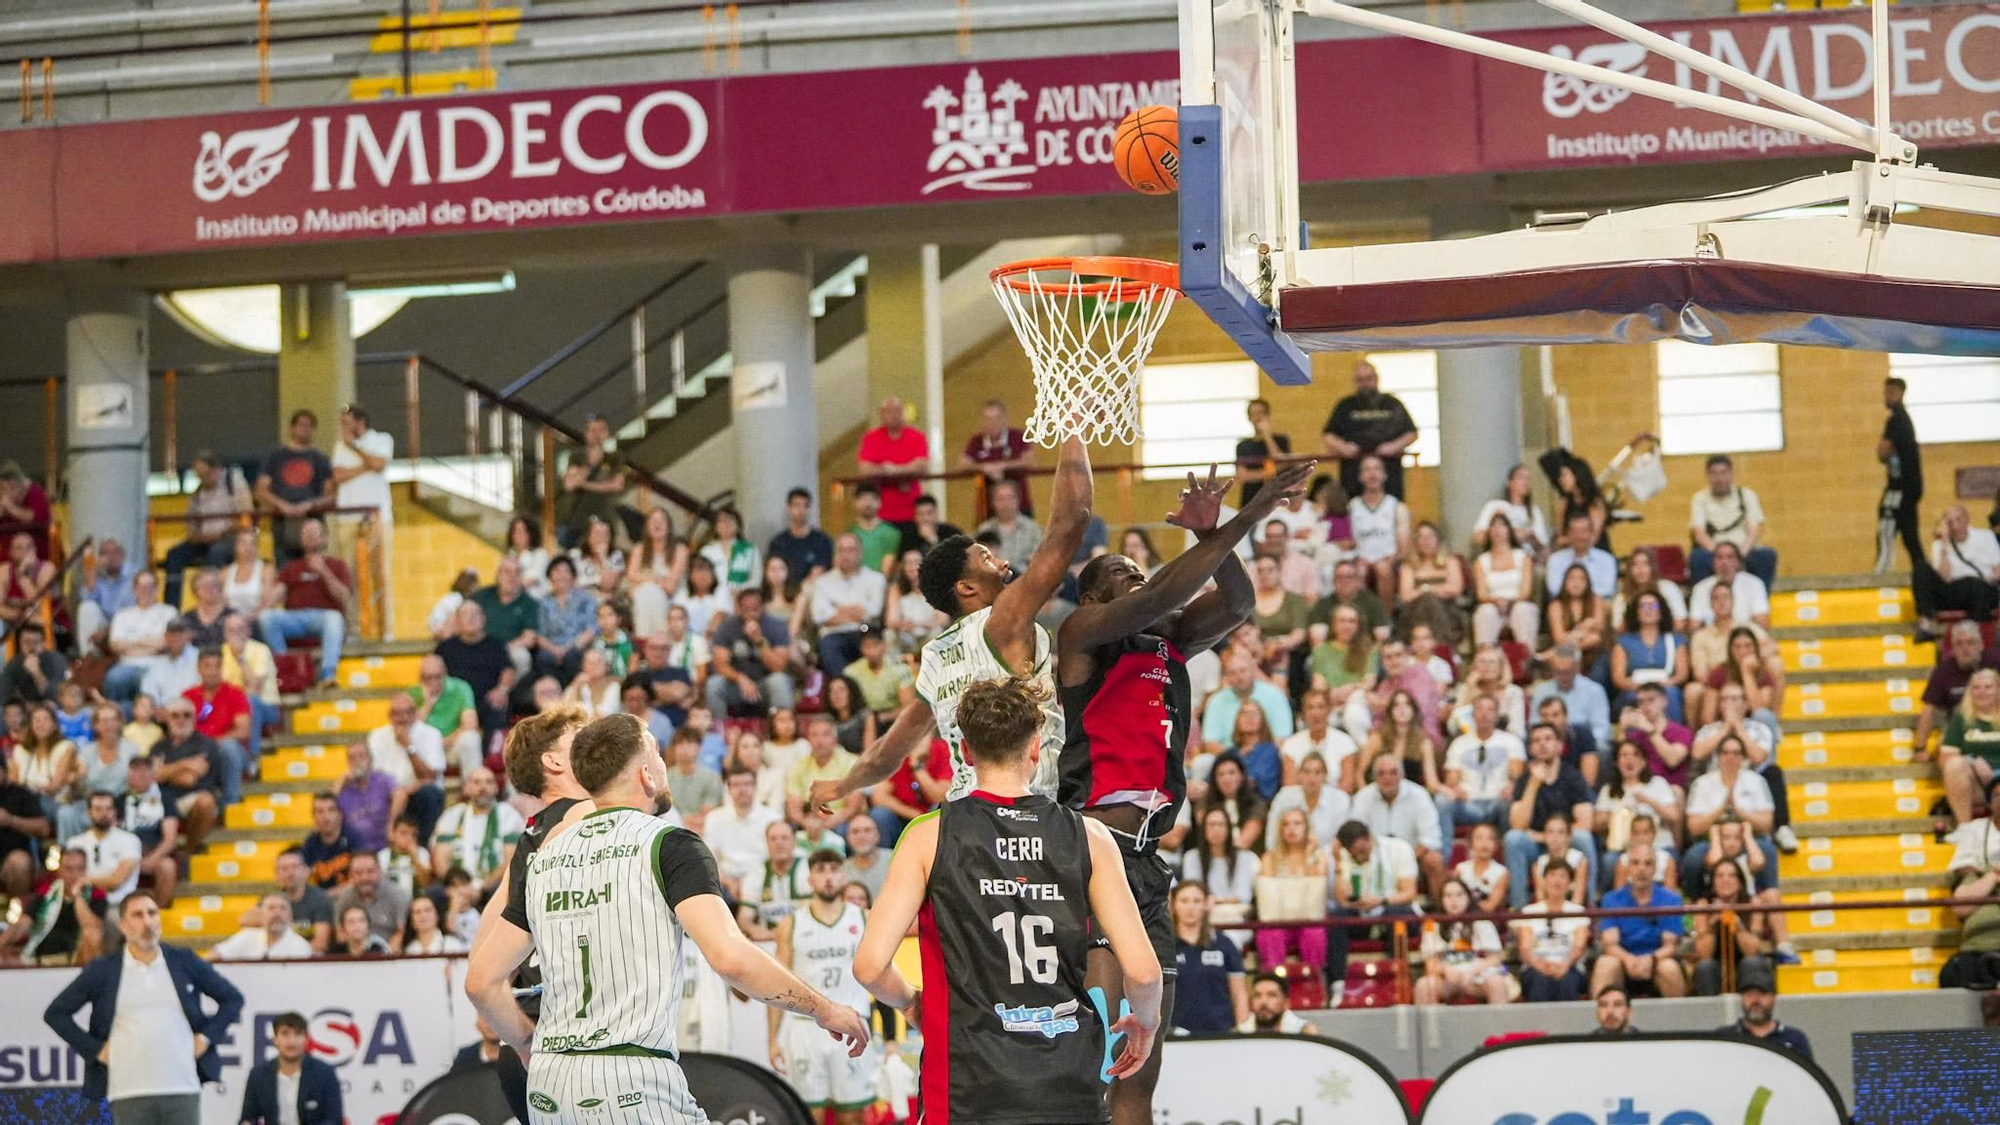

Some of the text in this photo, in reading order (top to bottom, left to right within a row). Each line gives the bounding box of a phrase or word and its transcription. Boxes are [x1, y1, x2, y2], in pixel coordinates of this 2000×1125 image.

[311, 90, 709, 192] IMDECO
[1036, 129, 1073, 166] DE
[1547, 132, 1660, 158] Instituto
[196, 184, 706, 240] Instituto Municipal de Deportes Córdoba
[1160, 719, 1173, 749] 7
[995, 837, 1043, 861] CERA
[979, 879, 1065, 901] REDYTEL
[992, 911, 1059, 984] 16
[575, 935, 593, 1018] 1
[822, 967, 842, 988] 27
[995, 1003, 1053, 1022] intra
[1040, 1017, 1079, 1038] gas
[533, 1094, 552, 1112] Ford
[617, 1092, 642, 1105] PRO
[580, 1108, 604, 1117] TYSA
